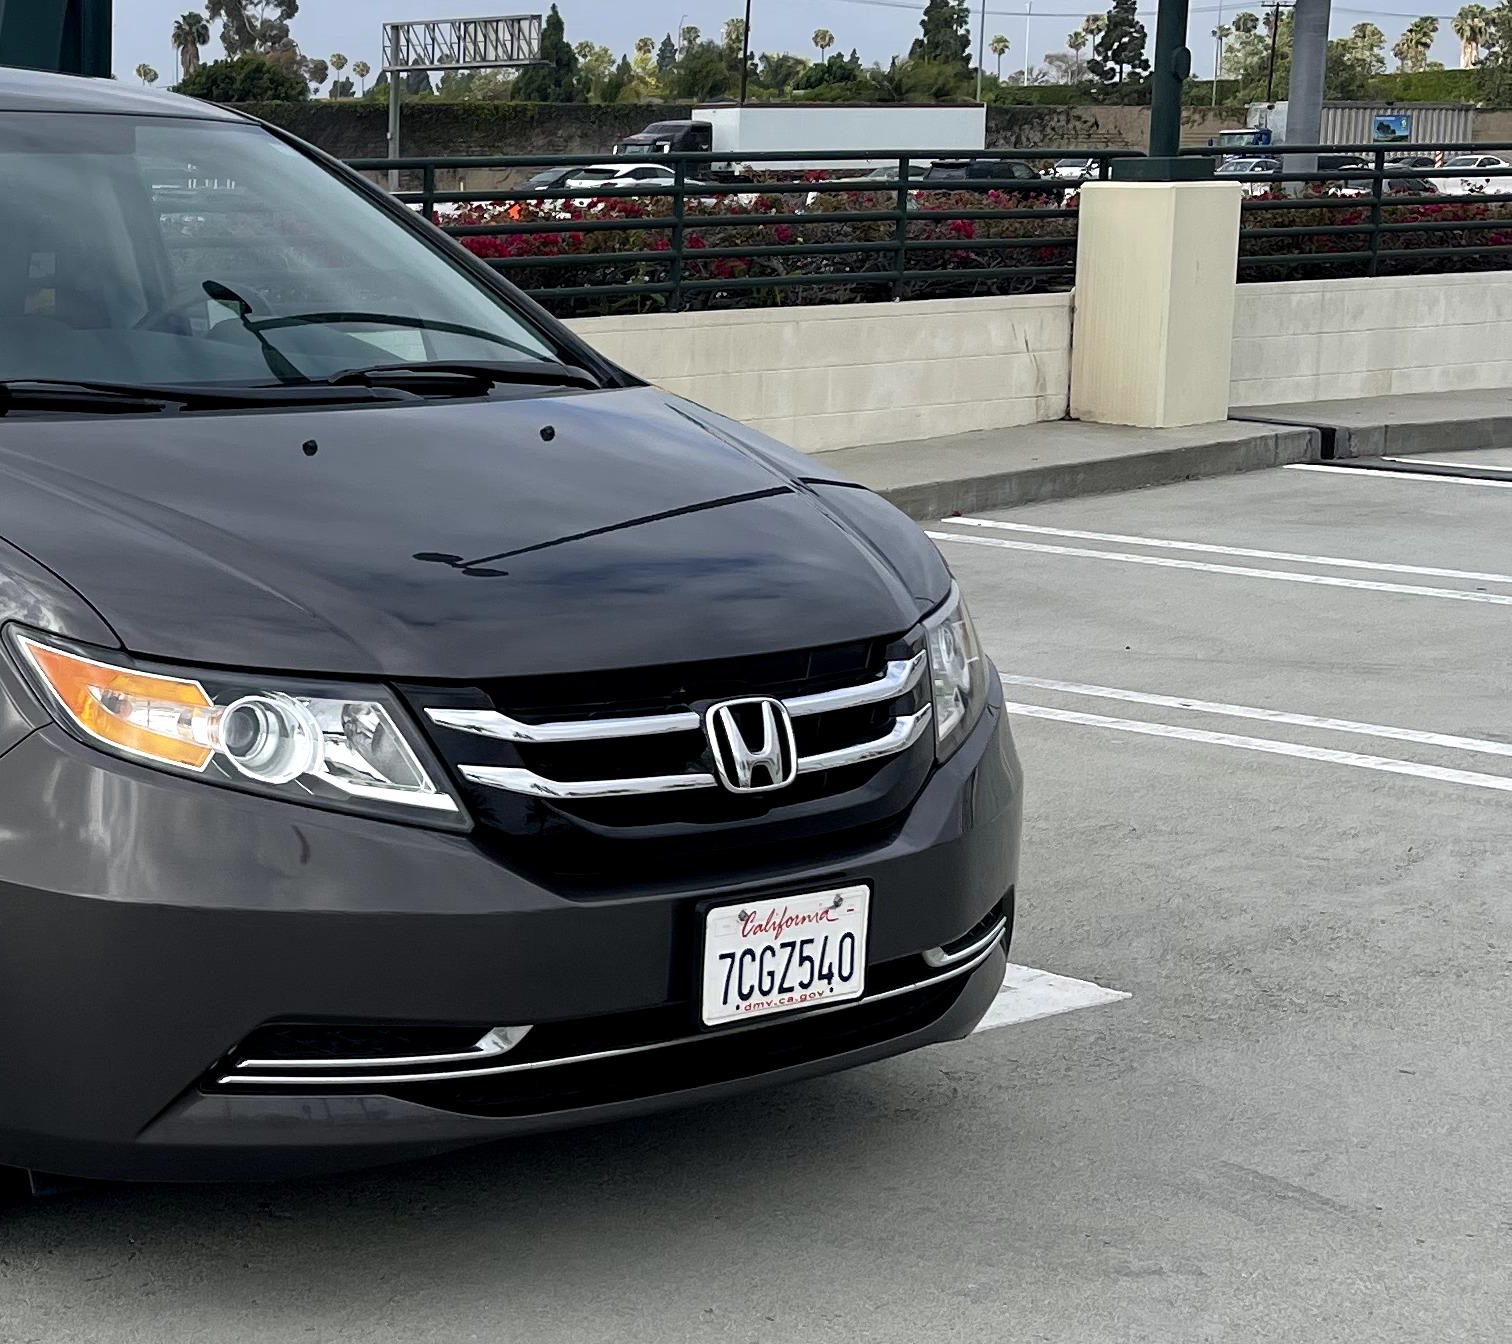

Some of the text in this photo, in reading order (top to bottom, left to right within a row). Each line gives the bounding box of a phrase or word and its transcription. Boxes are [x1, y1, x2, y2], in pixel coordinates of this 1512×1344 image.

[741, 906, 839, 941] California
[718, 931, 856, 1006] 7CGZ540
[744, 990, 825, 1012] dmv.ca.gov
